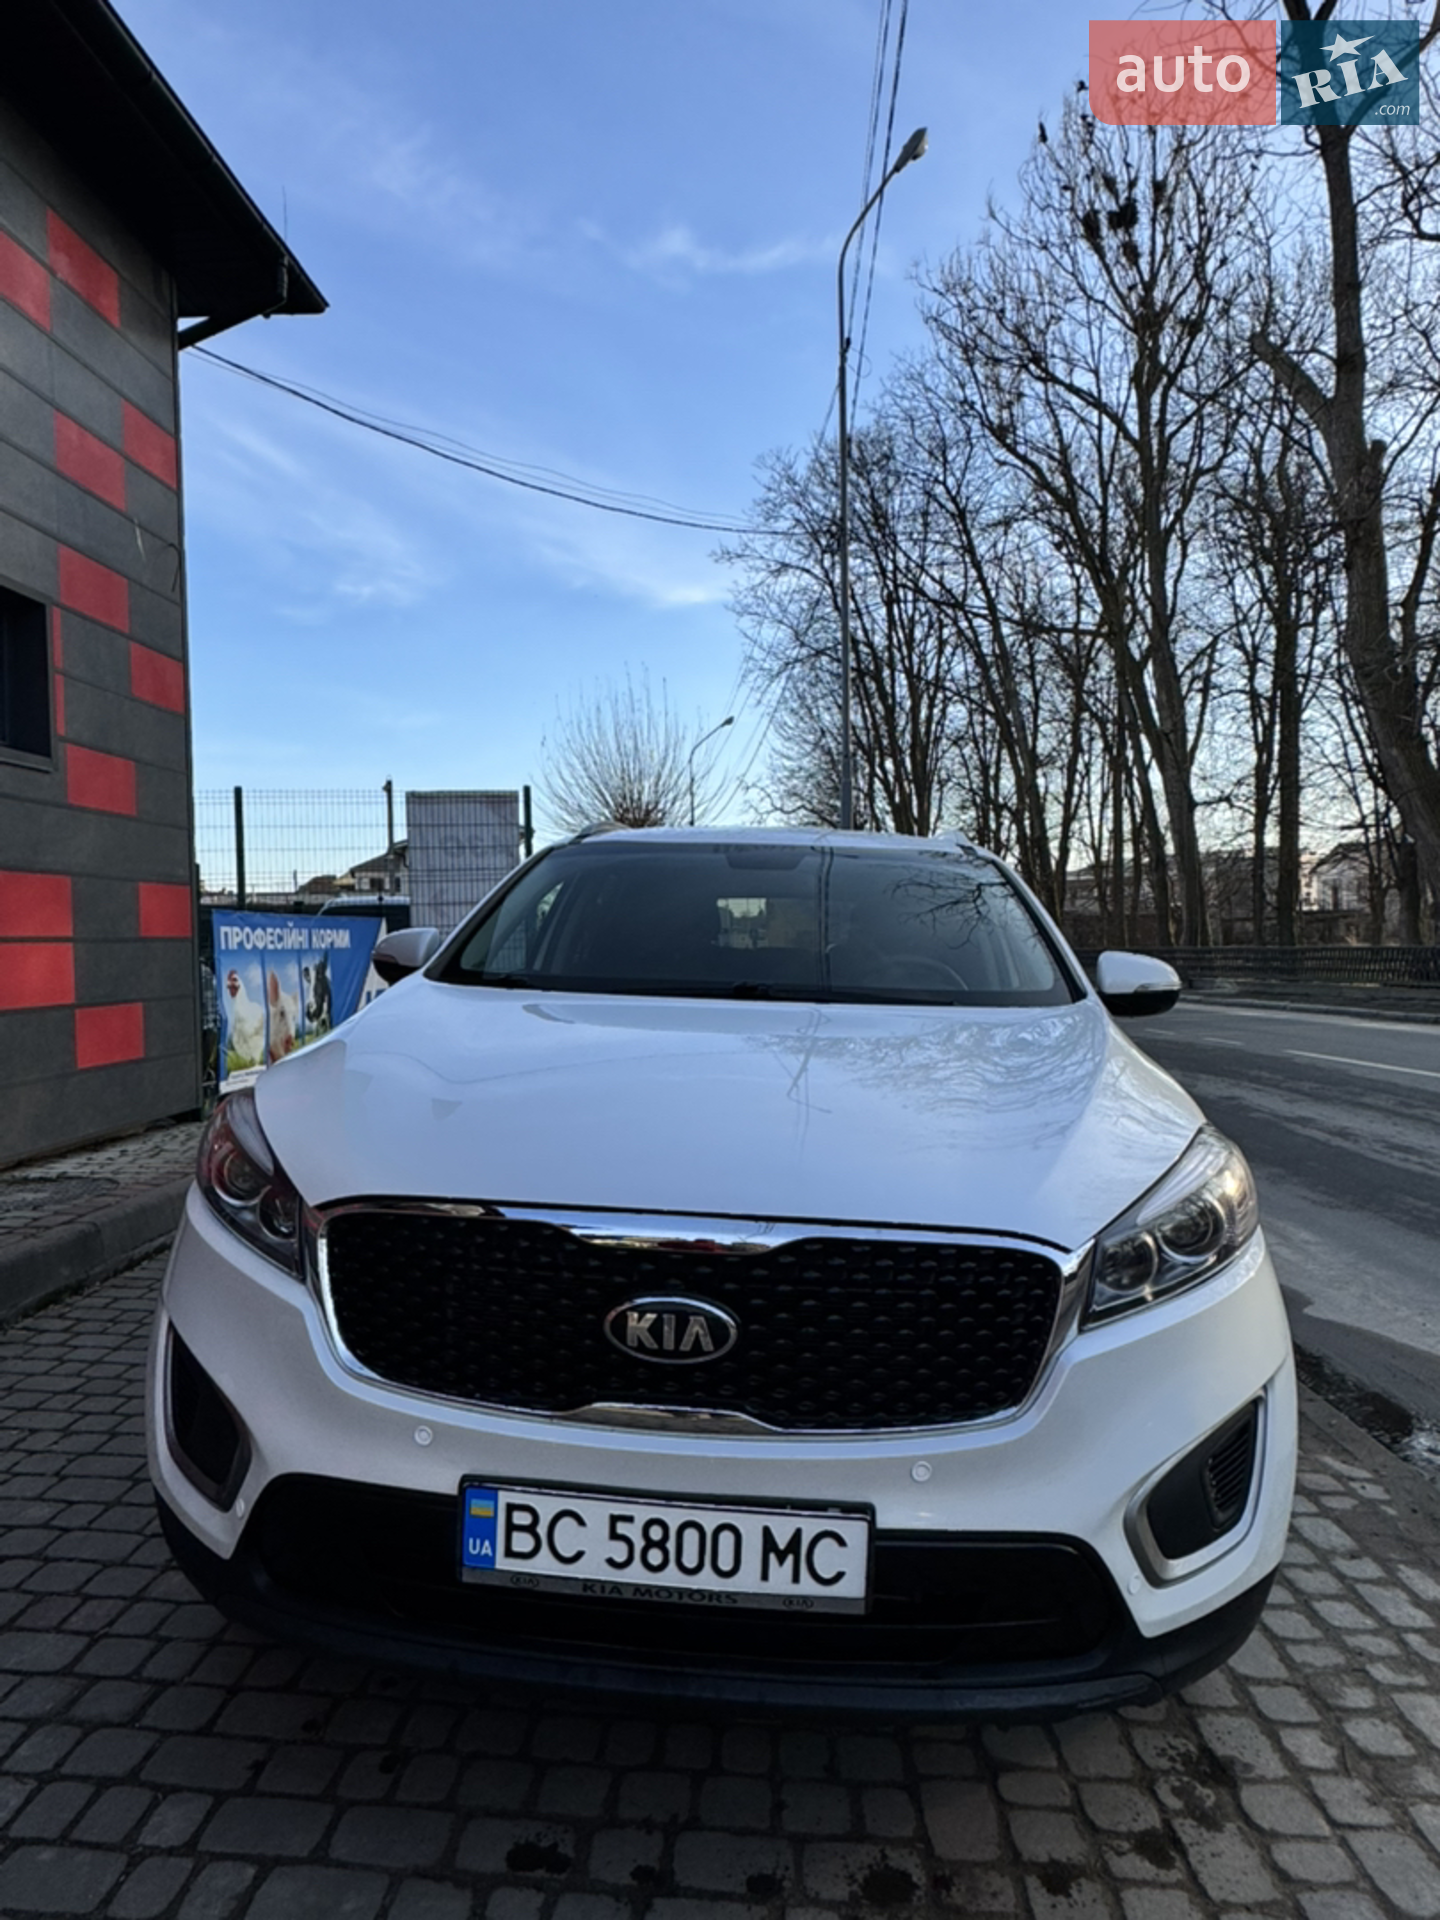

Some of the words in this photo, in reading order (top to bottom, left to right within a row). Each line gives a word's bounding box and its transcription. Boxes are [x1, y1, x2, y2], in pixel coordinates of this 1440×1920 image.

[219, 921, 309, 950] ПРОФЕСІЙНІ
[311, 928, 351, 949] КОРМИ
[626, 1311, 715, 1351] KIA
[468, 1537, 493, 1557] UA
[504, 1502, 588, 1565] BC
[604, 1513, 743, 1579] 5800
[760, 1525, 848, 1587] MC
[582, 1583, 623, 1596] KIA
[632, 1587, 738, 1604] MOTORS
